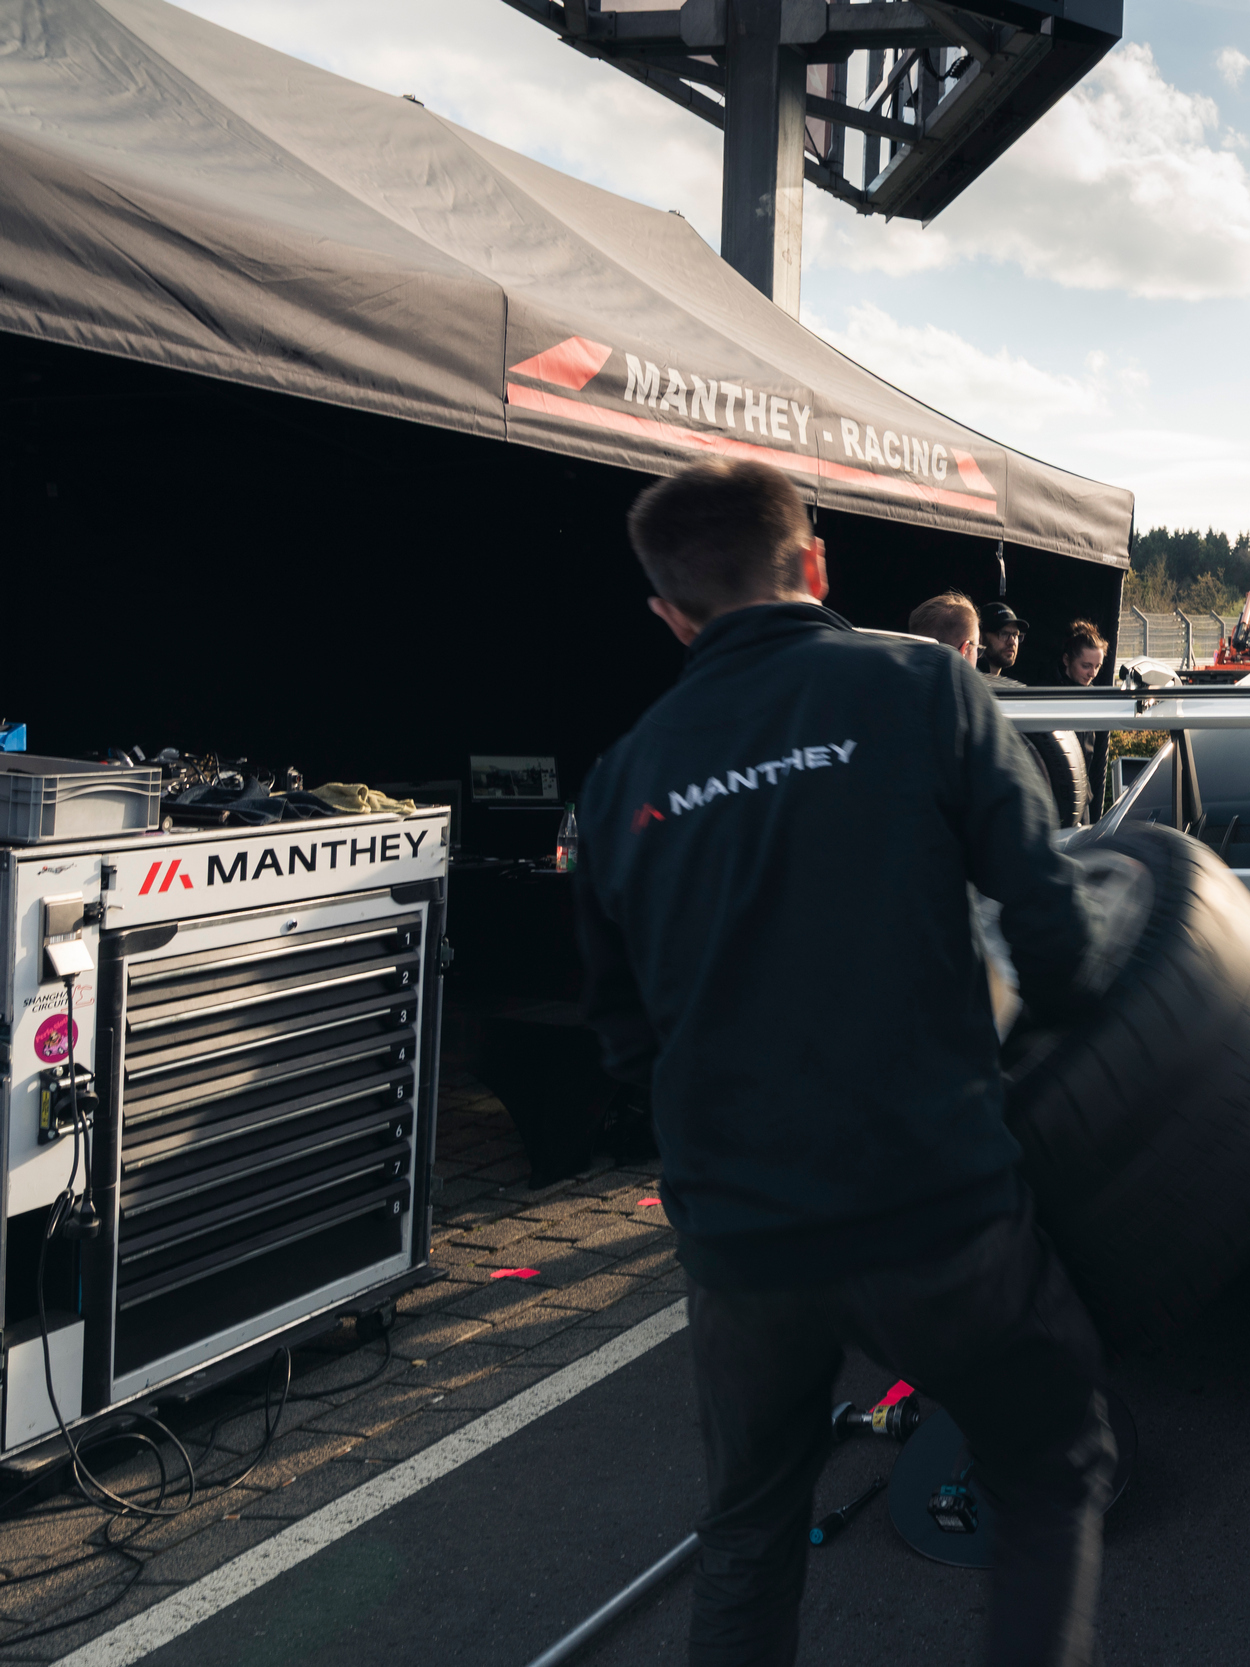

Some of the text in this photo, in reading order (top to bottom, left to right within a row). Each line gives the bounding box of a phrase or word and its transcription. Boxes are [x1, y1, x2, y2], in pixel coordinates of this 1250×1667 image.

[624, 353, 811, 444] MANTHEY
[841, 417, 948, 480] RACING
[668, 739, 858, 816] MANTHEY
[207, 829, 429, 886] MANTHEY
[405, 932, 411, 945] 1
[402, 970, 409, 985] 2
[400, 1009, 407, 1023] 3
[399, 1047, 405, 1060] 4
[397, 1085, 404, 1099] 5
[395, 1124, 402, 1138] 6
[394, 1160, 401, 1175] 7
[393, 1200, 400, 1214] 8
